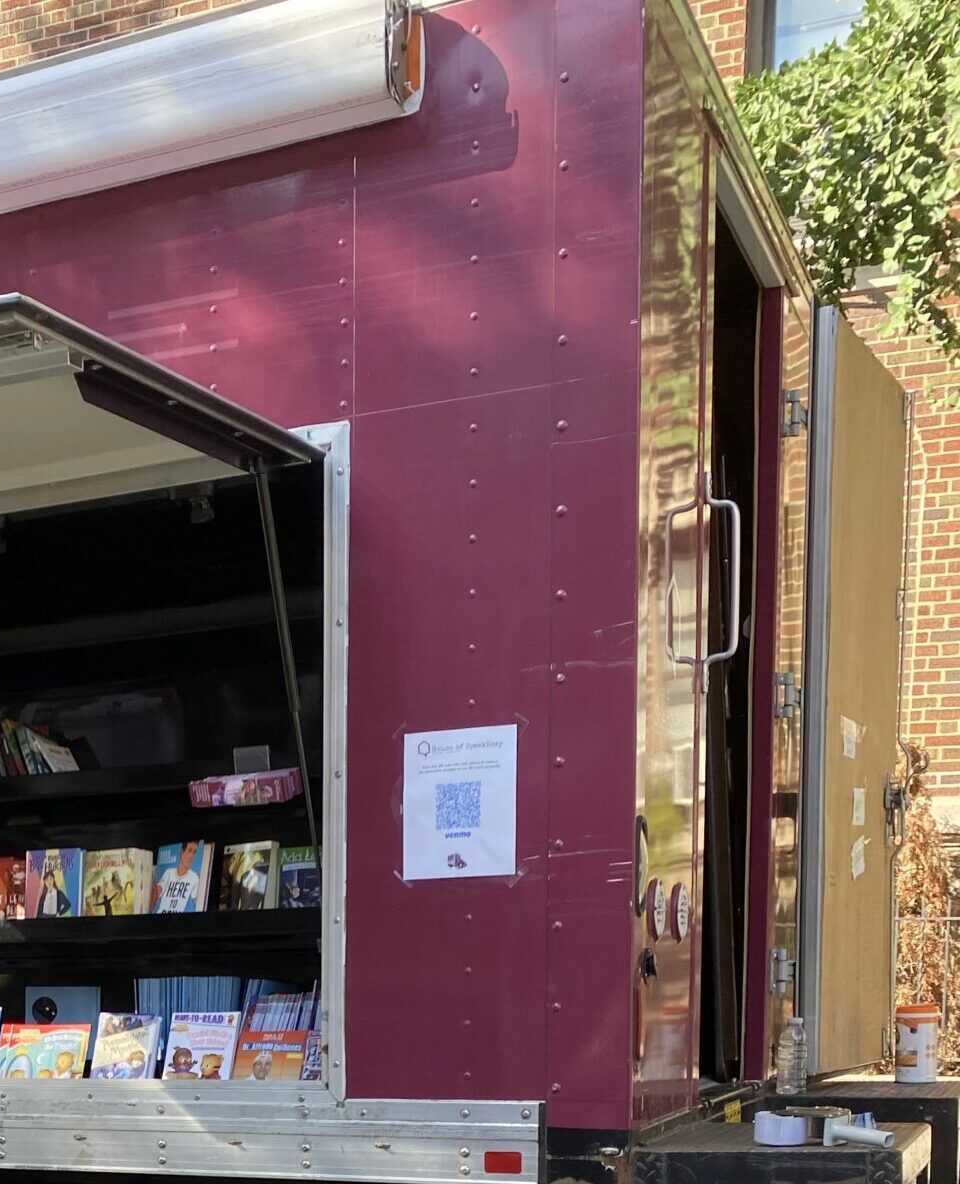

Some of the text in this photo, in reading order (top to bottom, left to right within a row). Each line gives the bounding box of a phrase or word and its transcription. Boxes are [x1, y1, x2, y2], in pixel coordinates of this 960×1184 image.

[445, 831, 471, 839] venmo
[166, 881, 191, 899] HERE
[169, 899, 179, 908] TO
